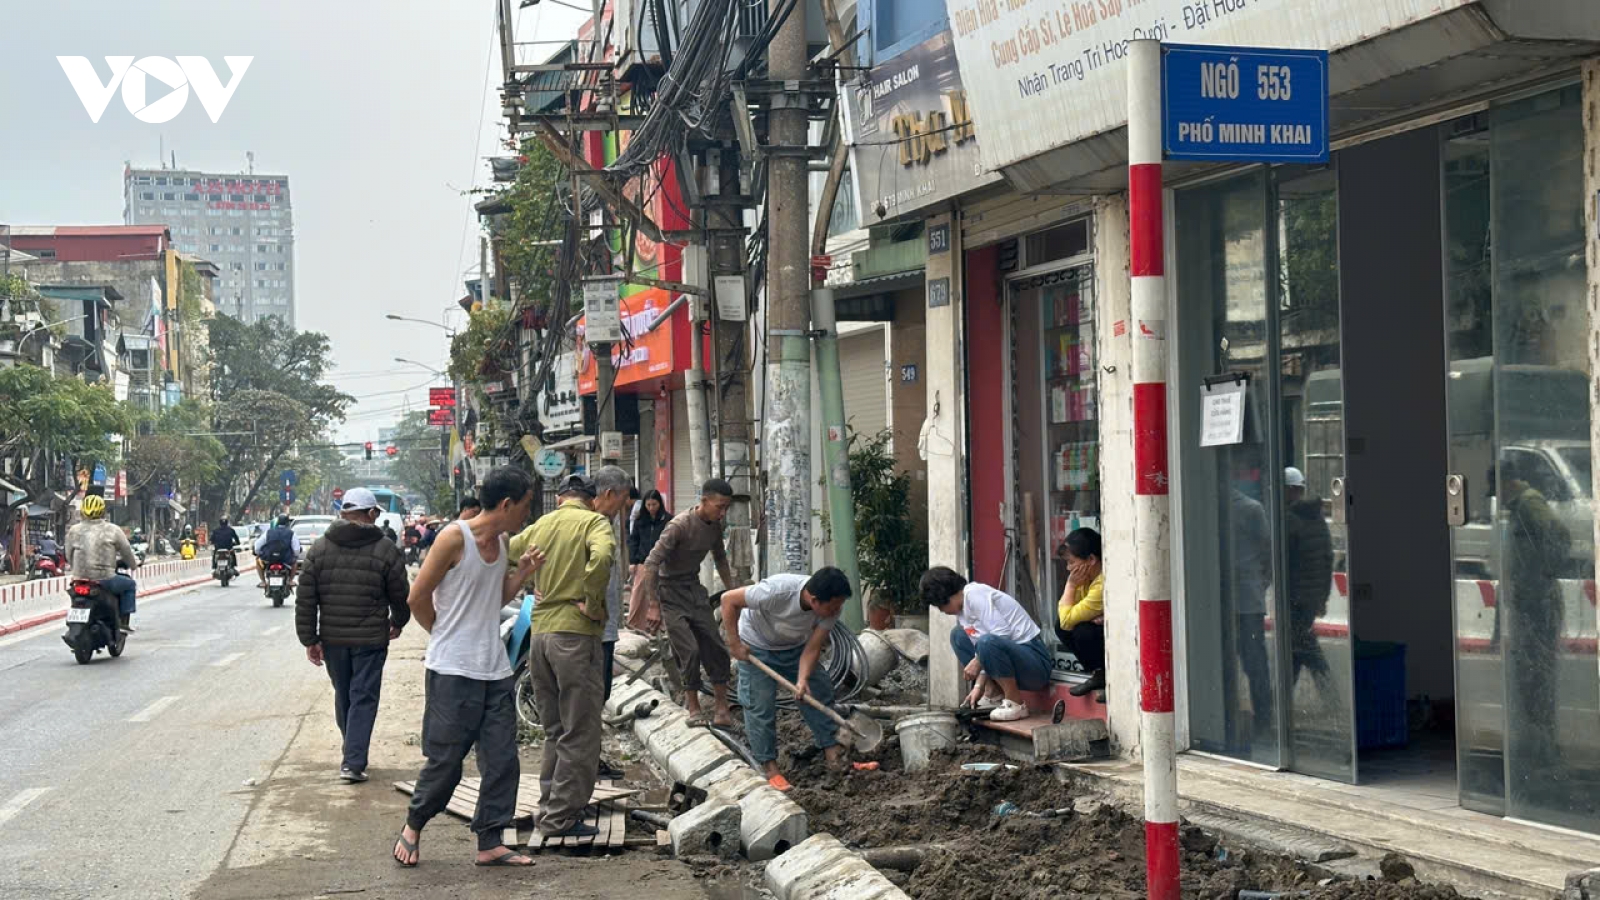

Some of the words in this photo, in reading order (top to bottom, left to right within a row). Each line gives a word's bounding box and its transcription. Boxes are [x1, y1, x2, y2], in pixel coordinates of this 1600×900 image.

[991, 40, 1020, 69] Cung
[1018, 19, 1041, 57] Cấp
[1072, 0, 1097, 32] Hoa
[1018, 72, 1049, 98] Nhận
[1048, 57, 1084, 85] Trang
[1083, 44, 1103, 71] Trí
[1103, 39, 1130, 63] Hoa
[1182, 0, 1211, 30] Đặt
[874, 79, 892, 99] HAIR
[893, 64, 920, 90] SALON
[1200, 56, 1240, 99] NGÕ
[1257, 64, 1292, 101] 553
[1179, 115, 1214, 143] PHỐ
[1219, 123, 1266, 144] MINH
[1270, 124, 1312, 145] KHAI
[929, 229, 946, 250] 551
